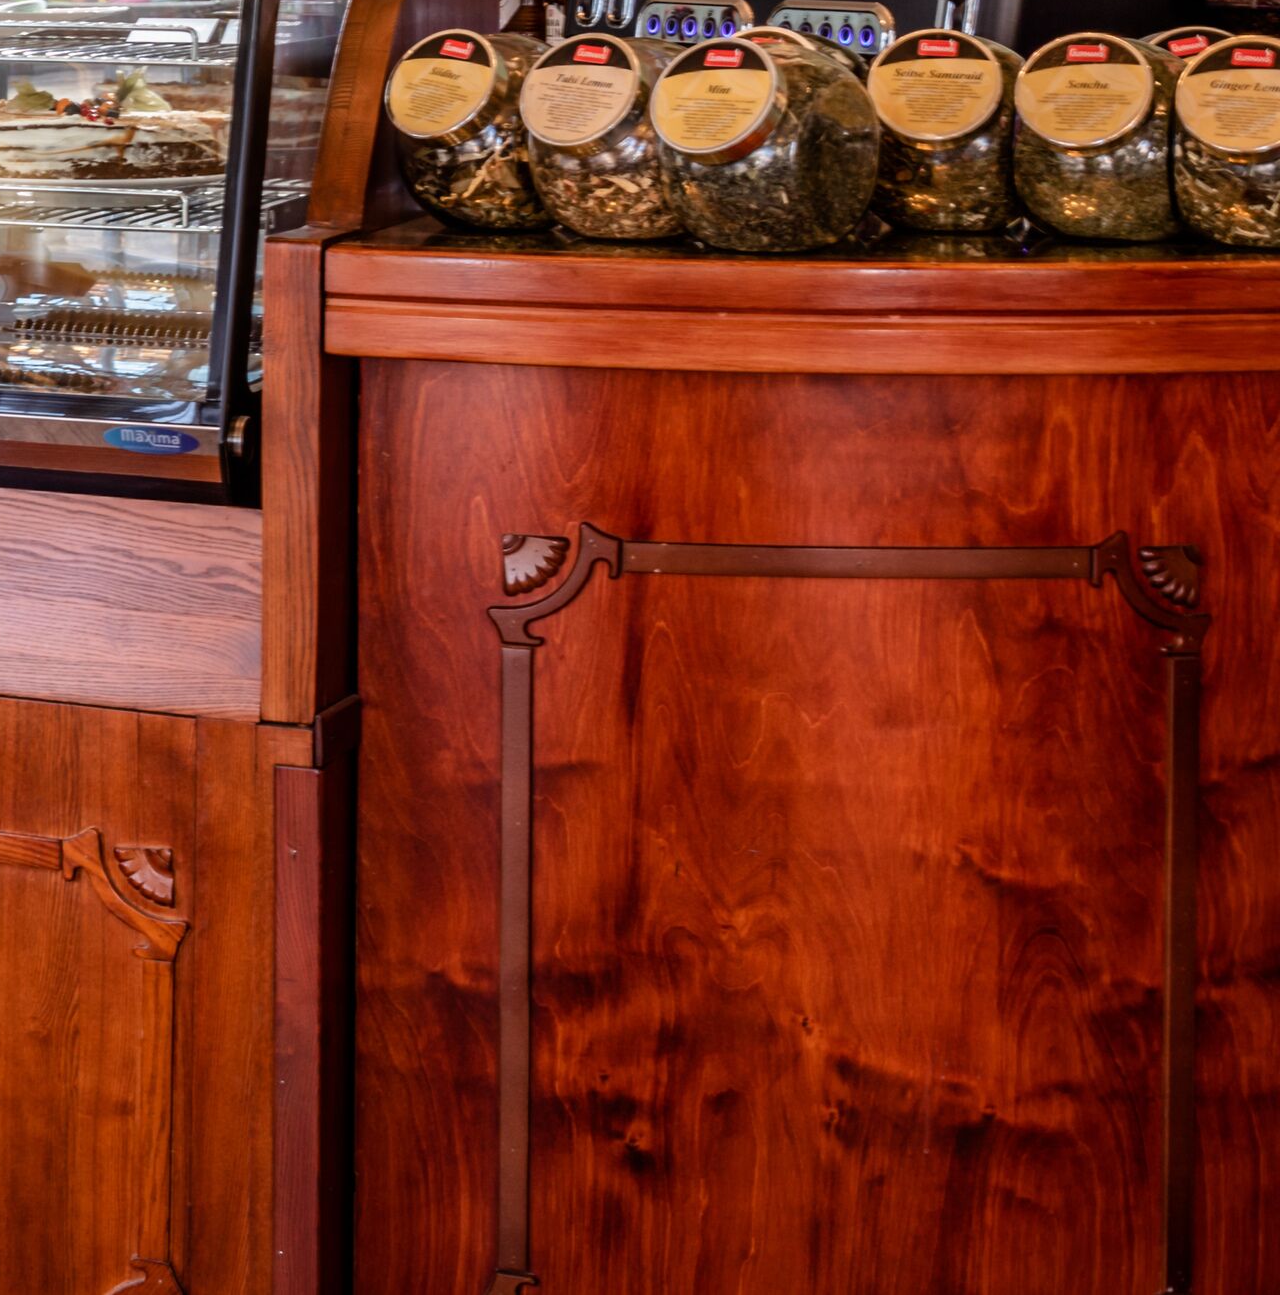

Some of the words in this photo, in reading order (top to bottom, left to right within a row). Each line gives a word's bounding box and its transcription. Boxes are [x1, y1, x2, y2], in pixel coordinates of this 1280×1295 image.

[893, 68, 926, 79] Seitse
[927, 68, 984, 80] Samuraid
[580, 76, 614, 88] Lemon
[1065, 79, 1110, 90] Sencha
[1209, 79, 1251, 92] Ginger
[1253, 82, 1280, 92] Lem
[707, 84, 731, 94] Mint
[120, 428, 181, 447] maxima
